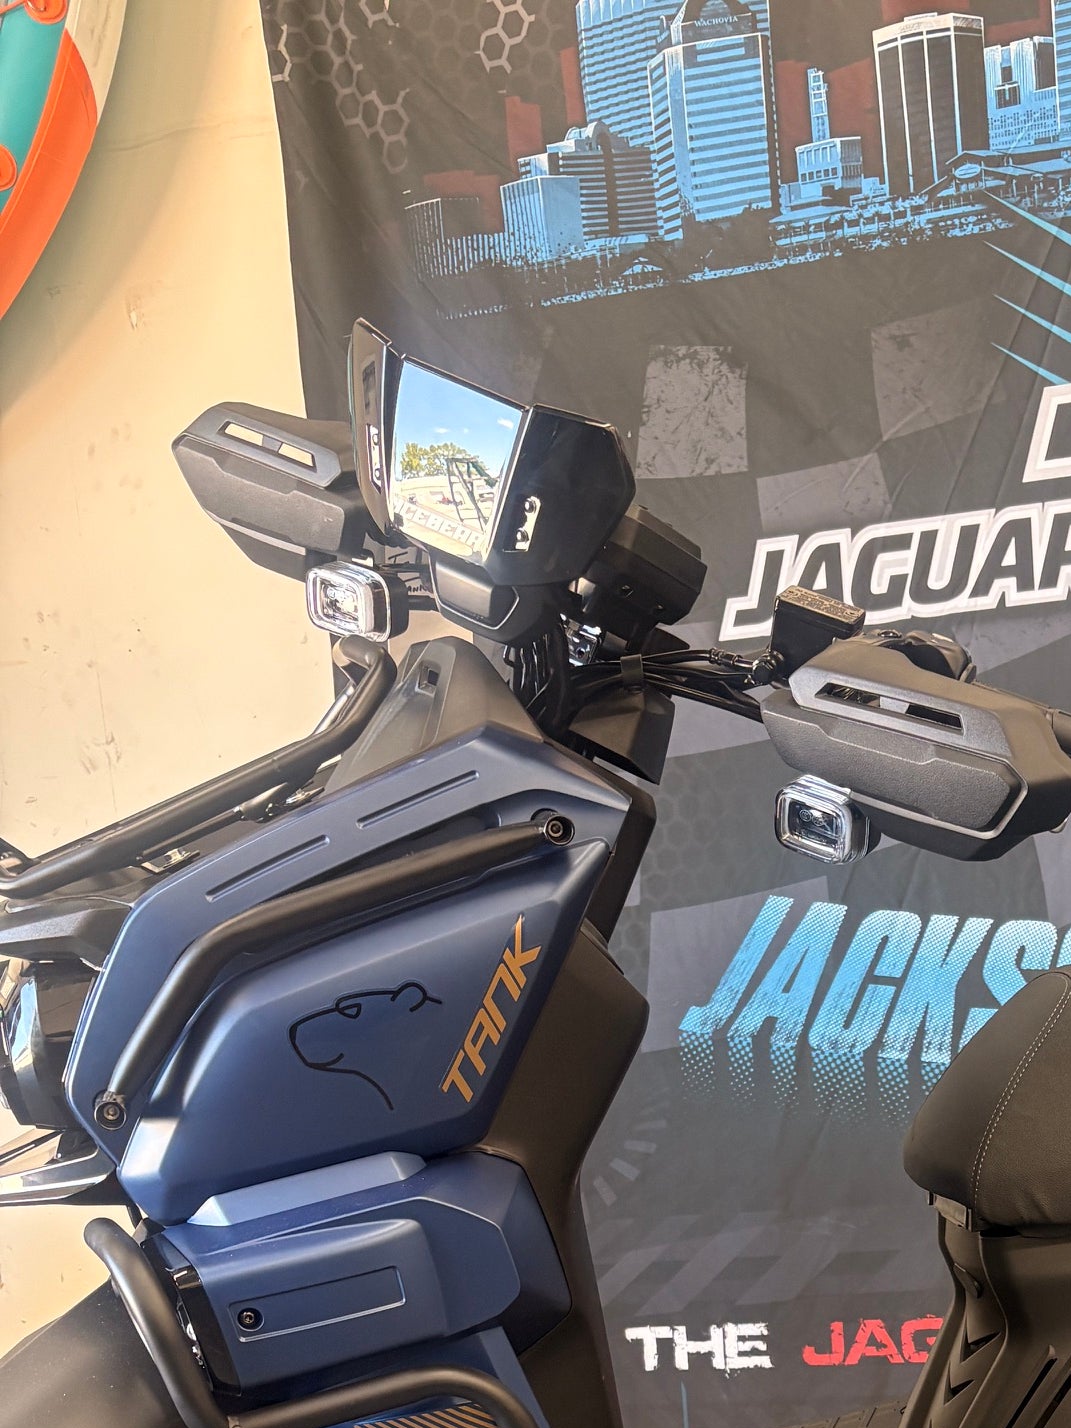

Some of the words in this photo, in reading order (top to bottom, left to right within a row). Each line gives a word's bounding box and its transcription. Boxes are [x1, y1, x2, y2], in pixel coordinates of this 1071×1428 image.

[694, 15, 738, 27] WACHOVIA
[441, 914, 541, 1102] TANK
[624, 1320, 775, 1378] THE
